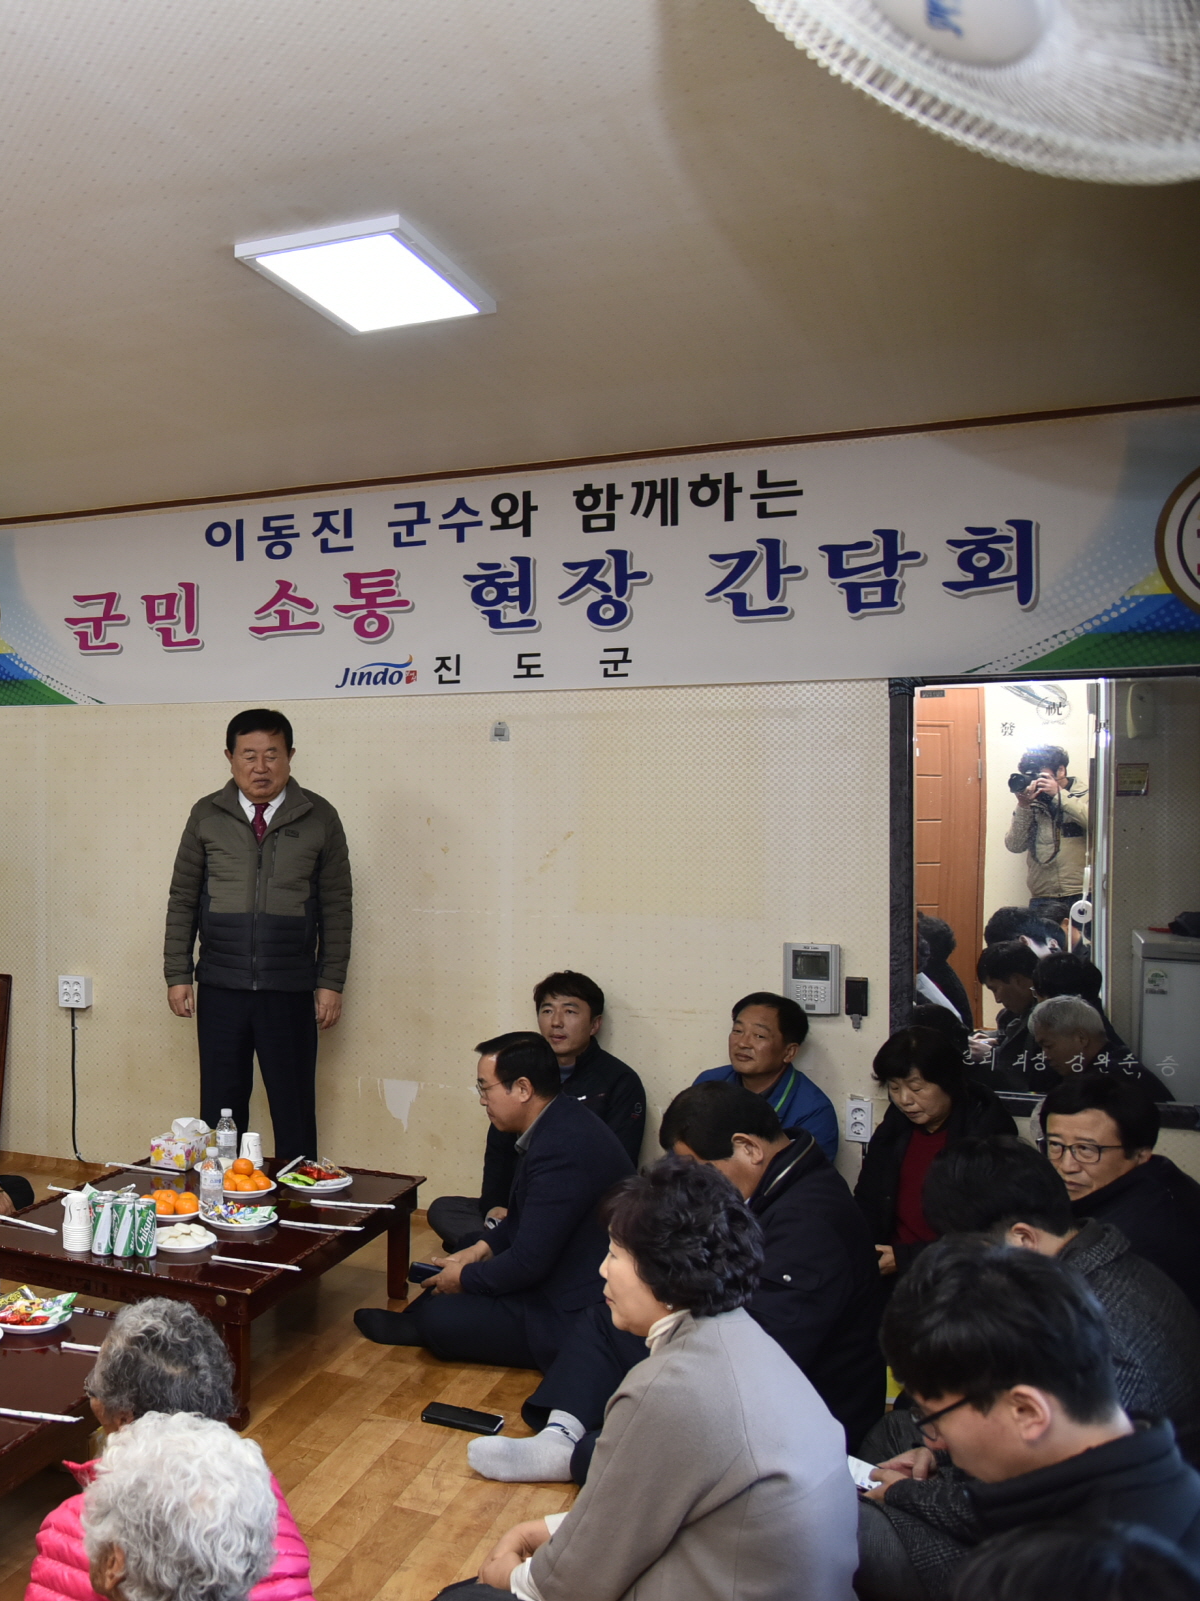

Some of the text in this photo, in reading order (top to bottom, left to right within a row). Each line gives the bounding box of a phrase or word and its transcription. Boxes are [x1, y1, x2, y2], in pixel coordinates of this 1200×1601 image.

[204, 469, 804, 562] 이동진 군수와 함께하는
[64, 518, 1037, 652] 군민 소통 현장 간담회
[335, 666, 404, 689] Jindo
[136, 1209, 156, 1253] Chilsung
